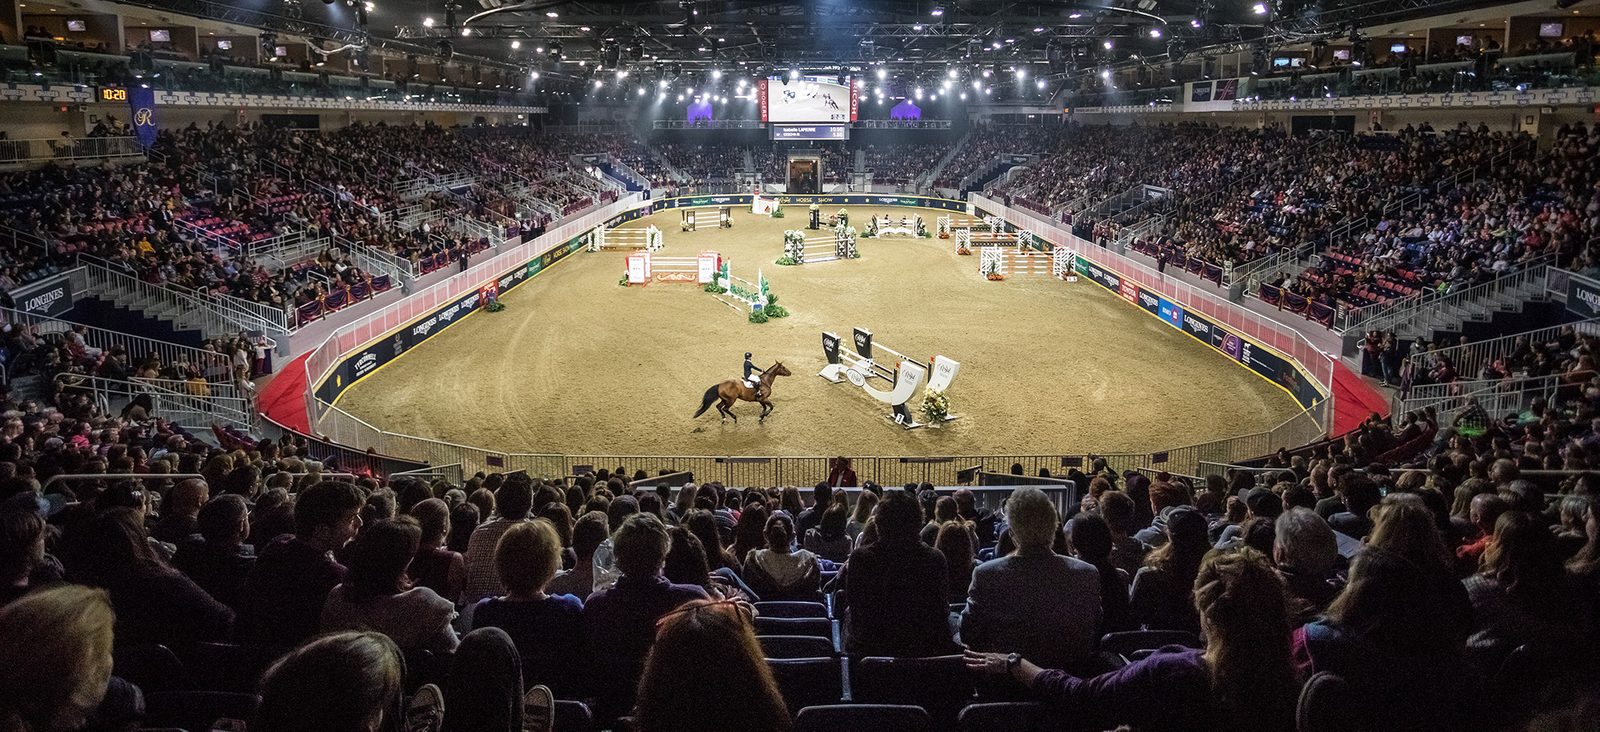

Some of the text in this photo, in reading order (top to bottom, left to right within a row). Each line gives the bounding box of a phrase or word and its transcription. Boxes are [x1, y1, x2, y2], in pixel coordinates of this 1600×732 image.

[103, 89, 126, 100] 10:20
[1121, 284, 1136, 298] TOYOTA
[1139, 291, 1159, 307] LONGINES
[25, 287, 64, 312] LONGINES
[461, 293, 480, 309] LONGINES
[438, 304, 460, 322] LONGINES
[413, 317, 437, 335] LONGINES
[1184, 314, 1209, 333] LONGINES
[897, 414, 903, 423] 3
